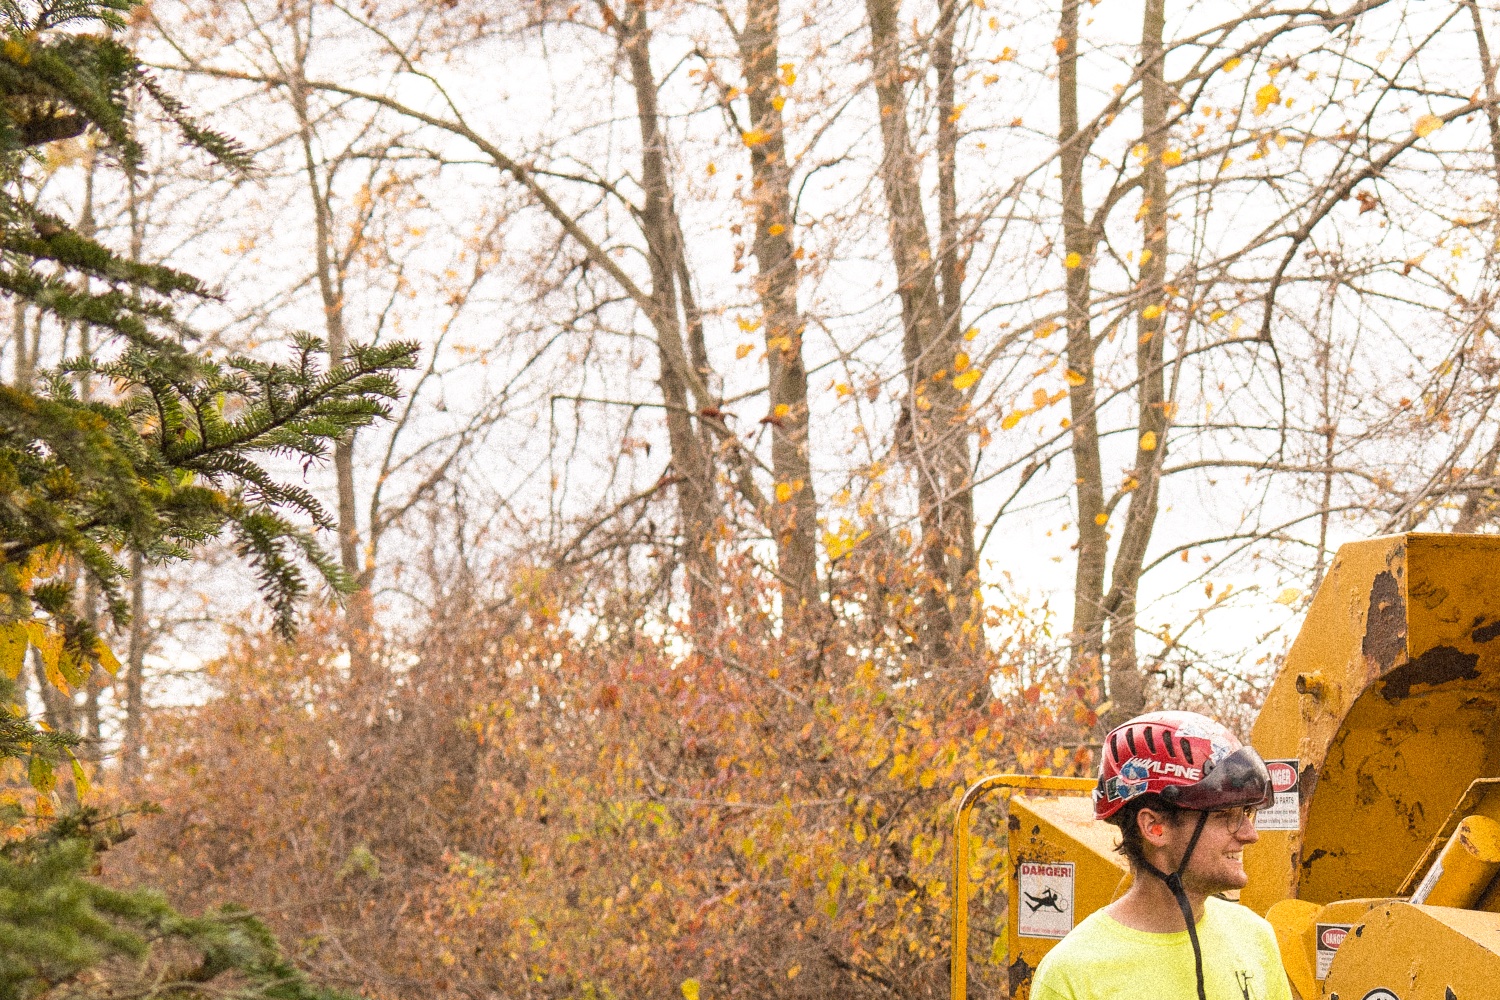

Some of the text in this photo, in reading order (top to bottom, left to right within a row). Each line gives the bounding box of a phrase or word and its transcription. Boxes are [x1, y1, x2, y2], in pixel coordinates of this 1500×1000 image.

[1148, 761, 1201, 780] ALPINE
[1269, 769, 1291, 785] NGER
[1022, 866, 1071, 877] DANGER!
